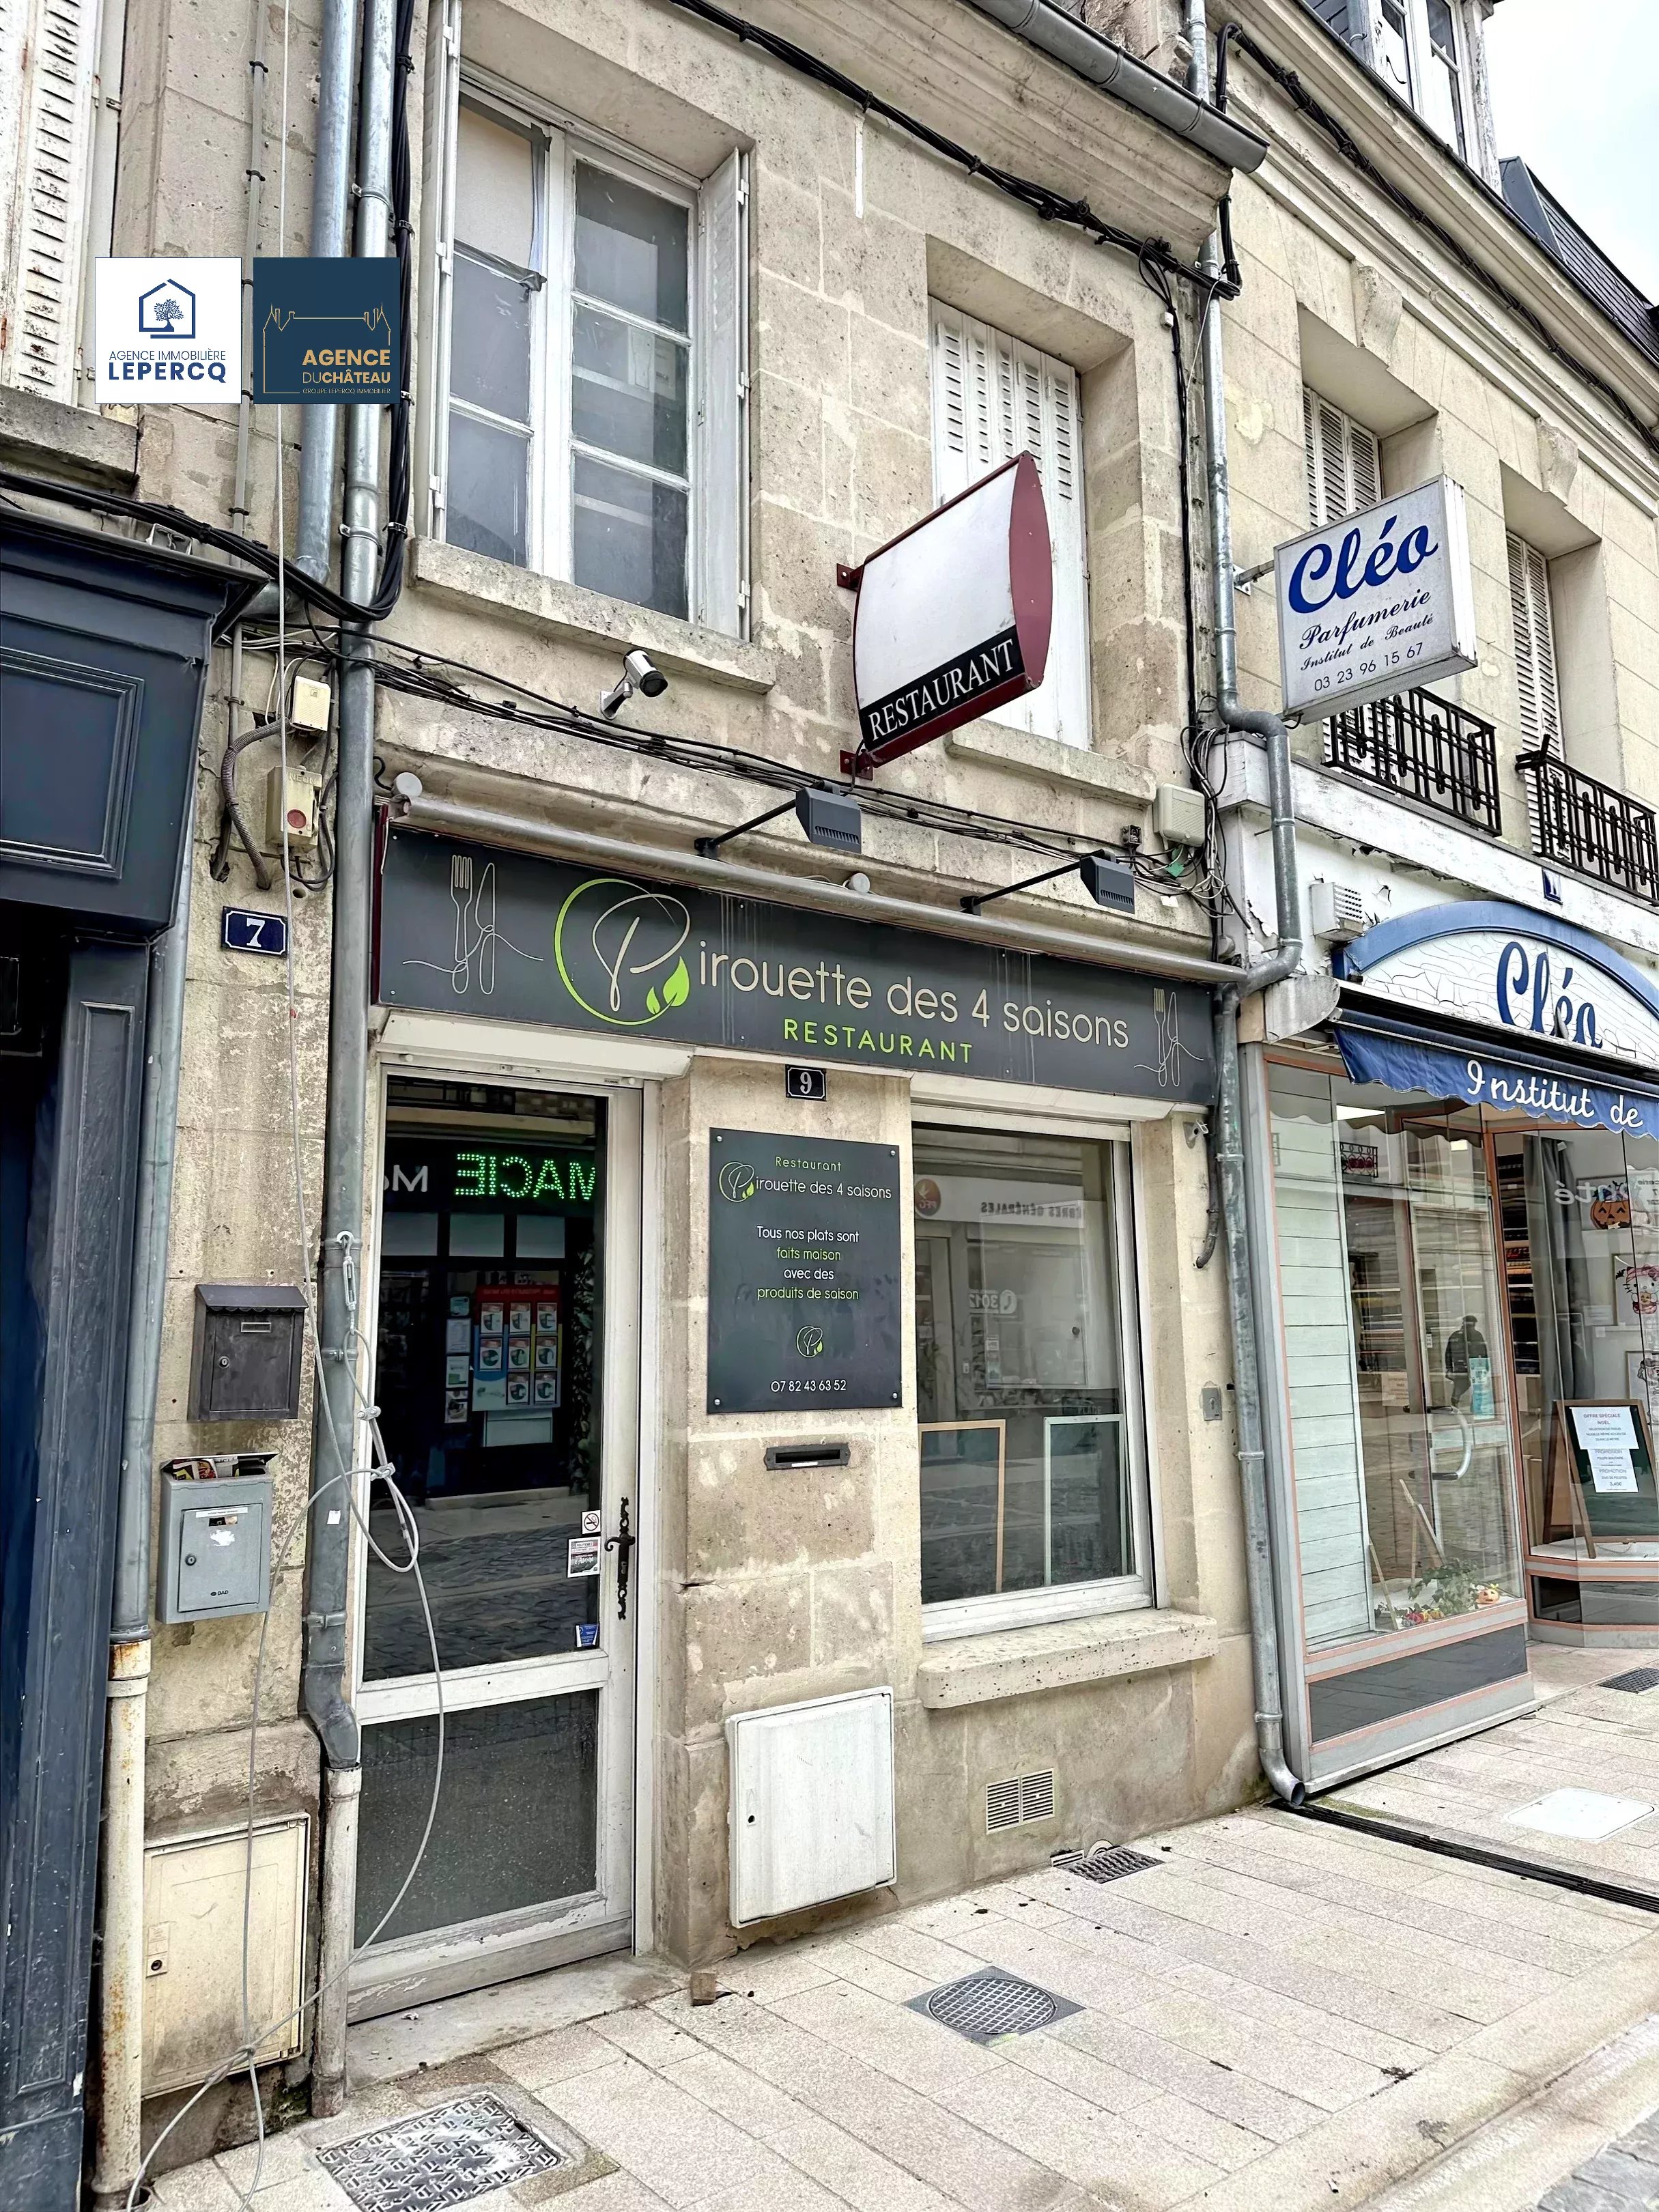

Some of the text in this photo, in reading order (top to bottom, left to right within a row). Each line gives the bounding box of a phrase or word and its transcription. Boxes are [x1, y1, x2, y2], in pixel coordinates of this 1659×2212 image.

[1288, 515, 1438, 613] Cléo
[1299, 589, 1431, 649] Parfumerie
[1301, 613, 1434, 670] Institut de Beauté
[1314, 642, 1423, 691] 03 23 96 15 67
[868, 638, 1013, 741] RESTAURANT
[289, 771, 316, 785] NEON
[246, 918, 265, 948] 7
[887, 976, 959, 1023] des
[972, 989, 990, 1027] 4
[1004, 1000, 1129, 1048] saisons
[784, 1018, 973, 1063] RESTAURANT
[799, 1071, 812, 1094] 9
[1466, 1059, 1644, 1128] Institut de
[776, 1156, 842, 1172] Restaurant
[810, 1180, 833, 1195] des
[836, 1182, 843, 1195] 4
[847, 1184, 892, 1199] saisons
[756, 1225, 860, 1243] Tous nos plats sont
[776, 1247, 842, 1260] faits maison
[784, 1268, 834, 1279] avec des
[757, 1287, 859, 1301] produits de saison
[771, 1379, 847, 1392] 07 82 43 63 52
